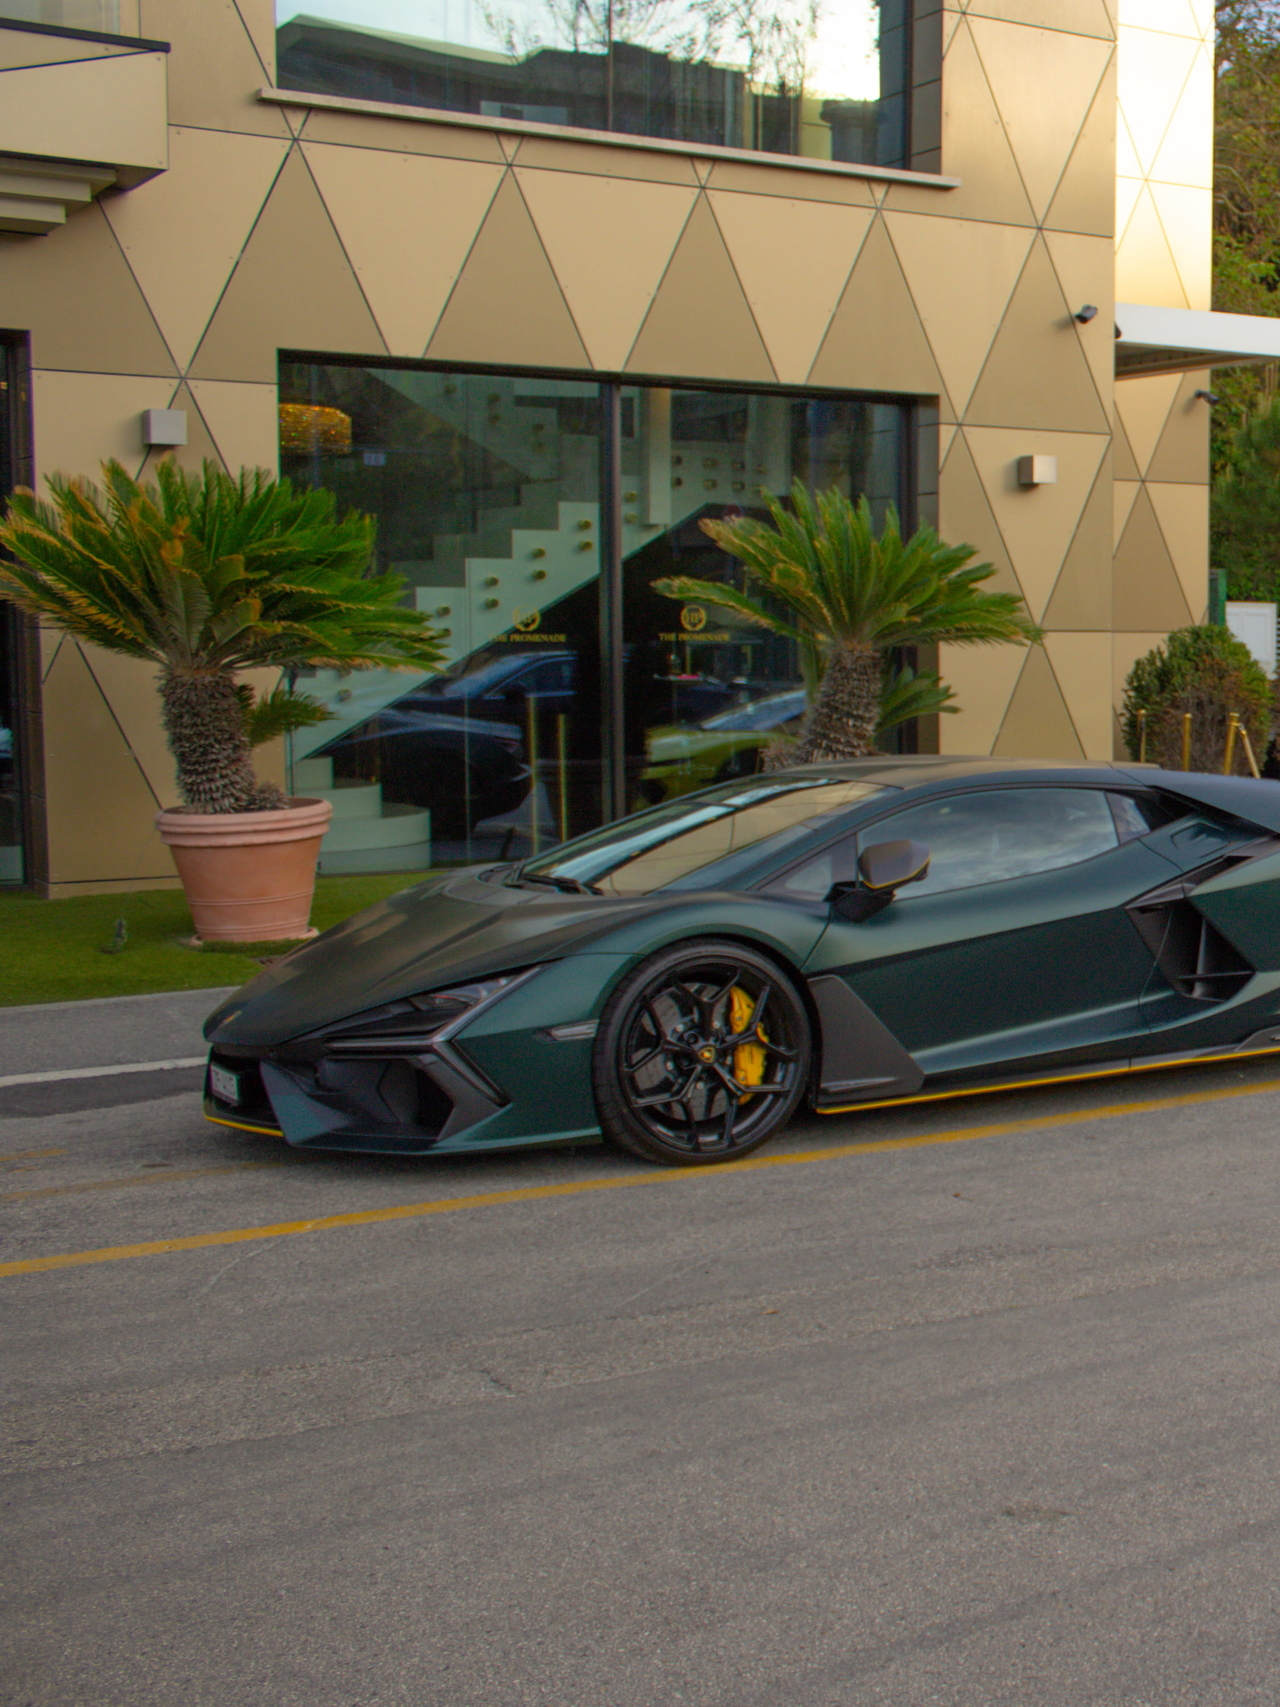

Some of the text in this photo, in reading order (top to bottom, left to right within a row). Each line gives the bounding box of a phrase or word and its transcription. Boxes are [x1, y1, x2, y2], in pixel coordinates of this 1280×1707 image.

[509, 633, 567, 642] PROMENADE
[658, 633, 730, 641] THE PROMENADE
